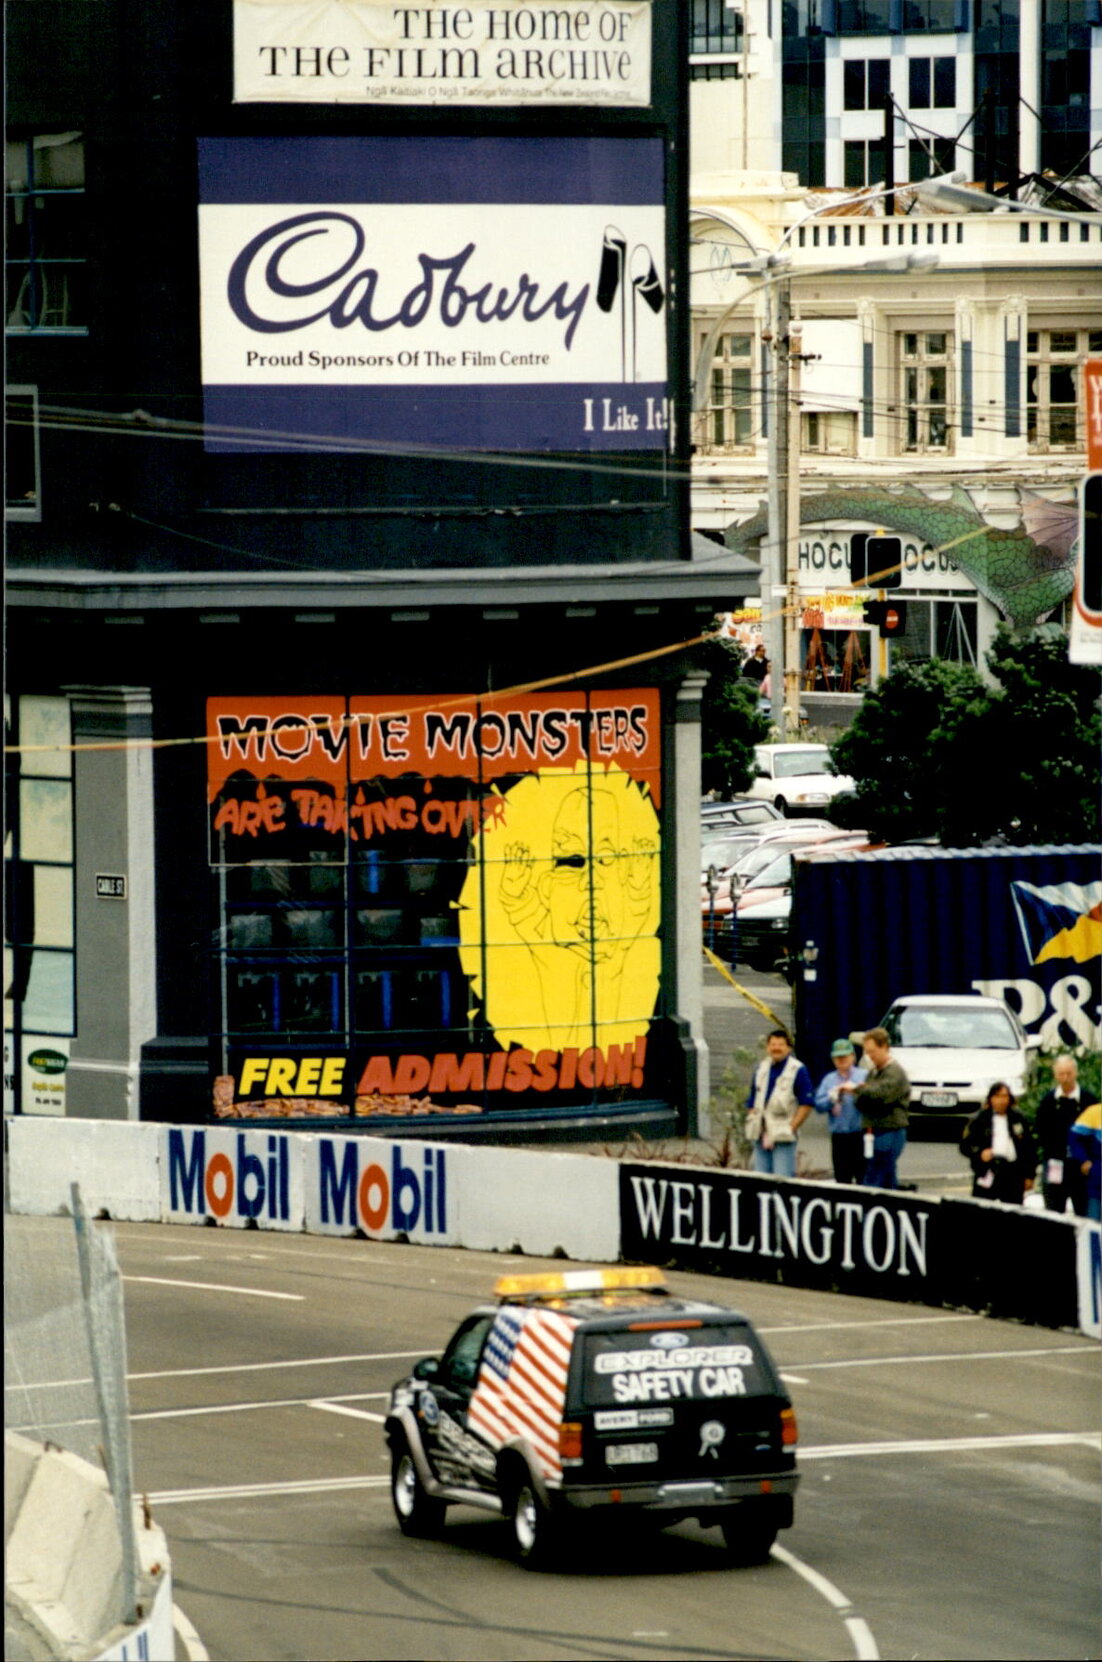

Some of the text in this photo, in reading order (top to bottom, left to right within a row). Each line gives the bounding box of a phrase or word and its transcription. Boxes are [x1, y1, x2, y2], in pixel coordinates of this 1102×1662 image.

[600, 11, 632, 42] OF
[227, 211, 591, 352] Cadbury
[246, 350, 550, 370] Proud Sponsors Of The Film Centre
[583, 397, 668, 431] I Like It!
[217, 704, 648, 763] MOVIE MONSTERS
[239, 1036, 648, 1096] FREE ADMISSION!
[168, 1129, 290, 1221] Mobil
[320, 1139, 447, 1234] Mobil
[630, 1176, 929, 1277] WELLINGTON
[594, 1345, 753, 1374] EXPLORER
[612, 1367, 747, 1403] SAFETY CAR
